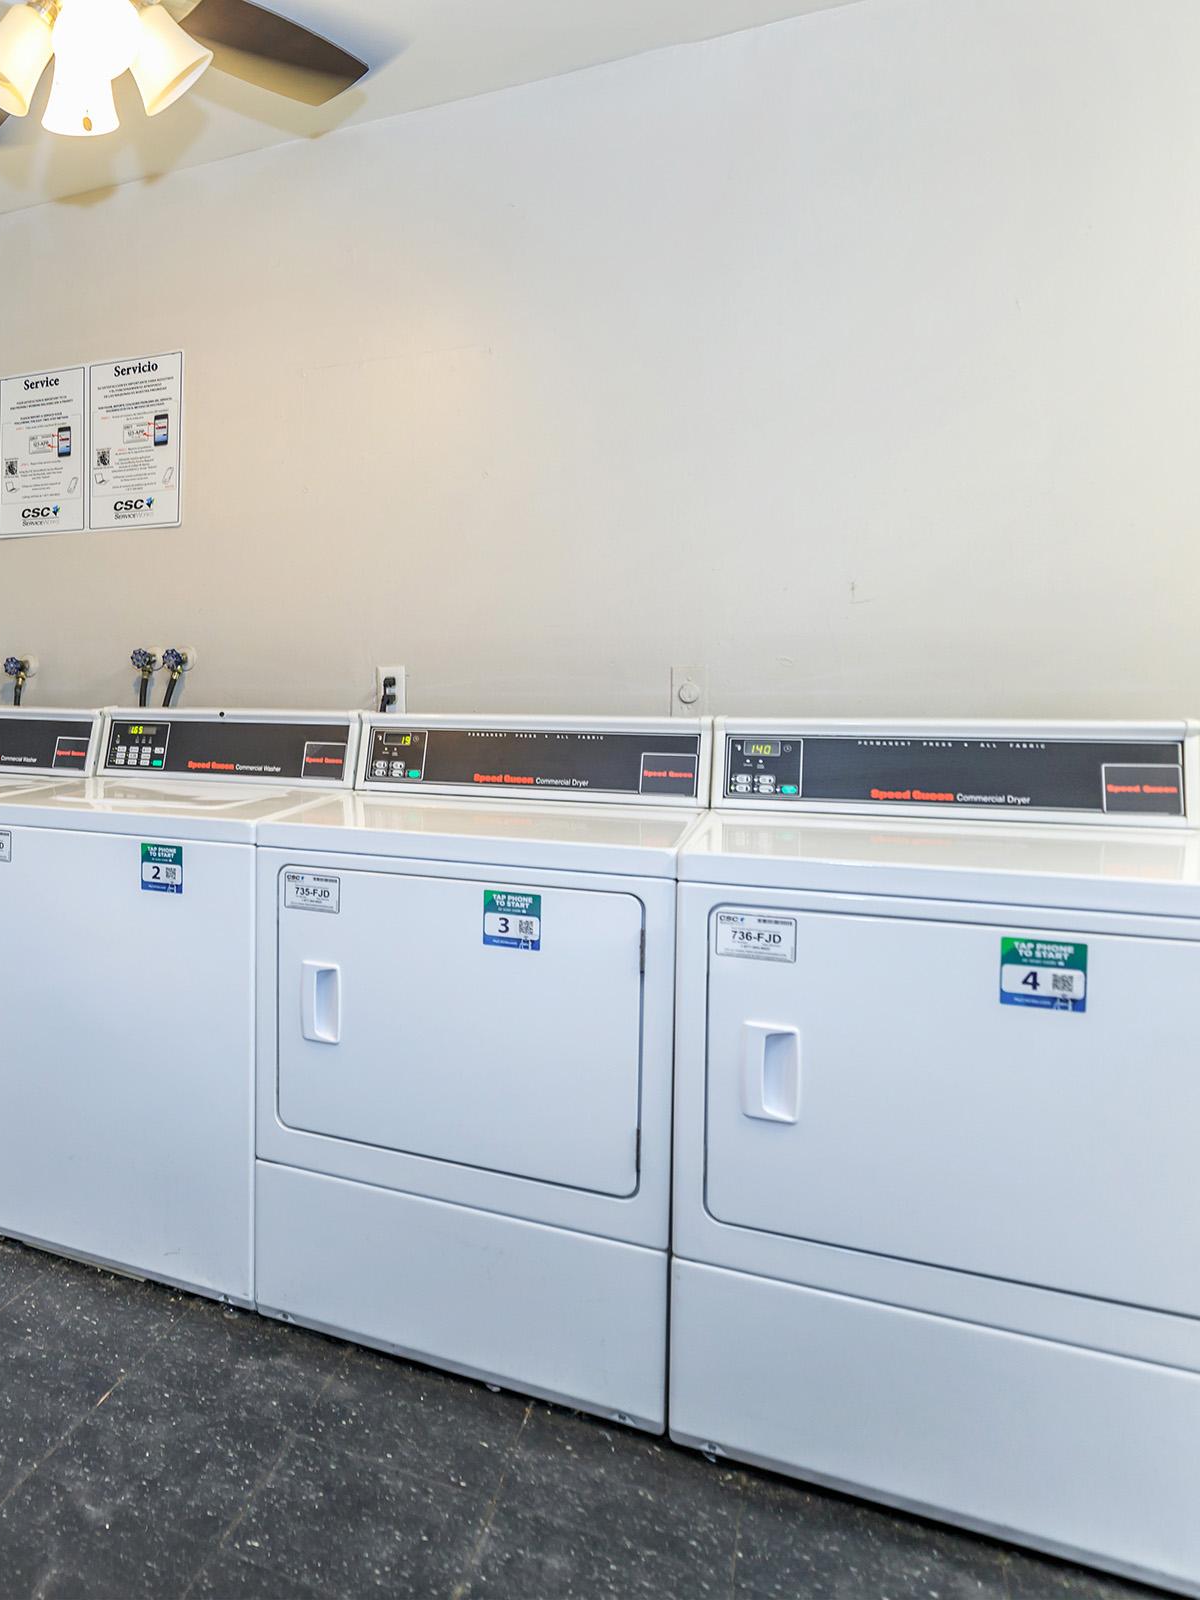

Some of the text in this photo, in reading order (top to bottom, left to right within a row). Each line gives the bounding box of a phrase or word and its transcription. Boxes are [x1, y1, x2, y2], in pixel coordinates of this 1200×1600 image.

[114, 360, 159, 378] Servicio
[23, 376, 60, 391] Service
[113, 498, 144, 511] CSC
[21, 506, 51, 519] CSC
[401, 735, 411, 746] 19
[751, 744, 772, 755] 140
[473, 772, 589, 788] Speed Queen Commercial Dryer
[643, 769, 694, 779] Speed Queen
[1106, 783, 1179, 795] Speed Queen
[870, 787, 1031, 806] Speed Queen Commercial Dryer
[152, 865, 161, 880] 2
[295, 886, 330, 899] 735-FJD
[492, 893, 534, 905] TAP PHONE
[495, 899, 530, 909] TO START
[498, 917, 510, 934] 3
[731, 929, 782, 945] 736-FJD
[1013, 941, 1075, 955] TAP PHONE
[1018, 948, 1070, 961] TO START
[1022, 971, 1040, 991] 4
